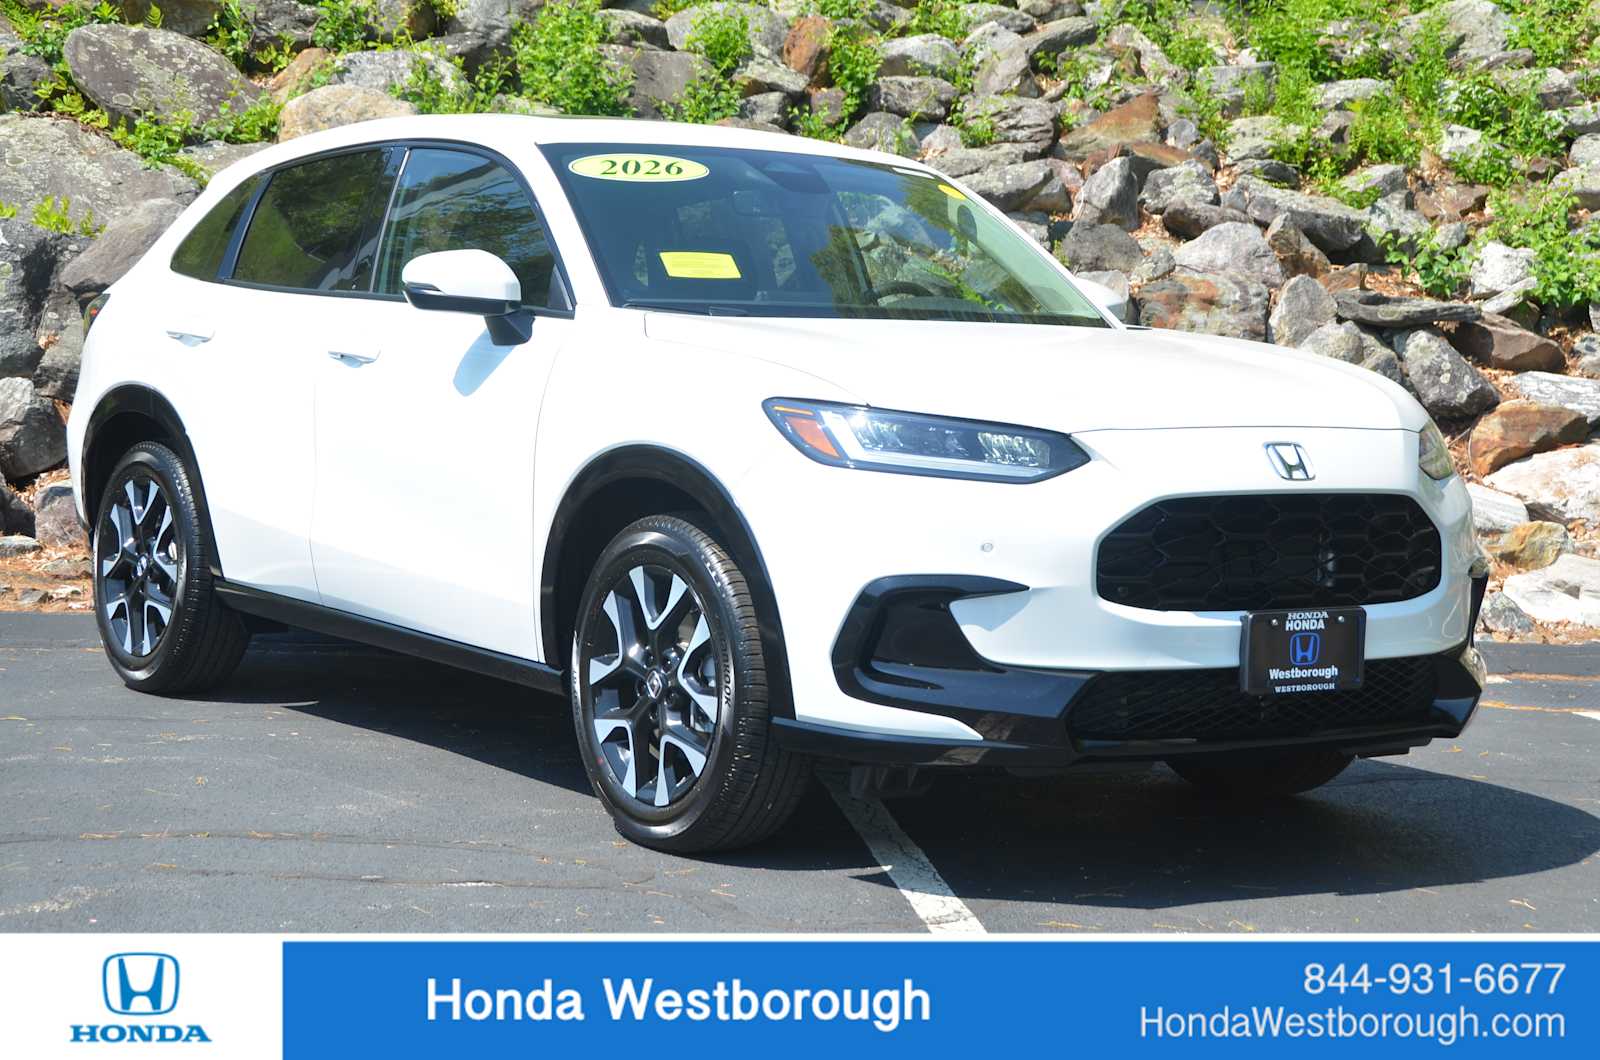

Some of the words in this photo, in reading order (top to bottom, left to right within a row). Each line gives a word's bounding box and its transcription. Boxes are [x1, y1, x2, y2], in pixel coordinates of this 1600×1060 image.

[600, 159, 684, 175] 2026
[1287, 610, 1329, 620] HONDA
[1285, 618, 1326, 632] HONDA
[1269, 664, 1339, 680] Westborough
[1274, 683, 1336, 693] WESTBOROUGH
